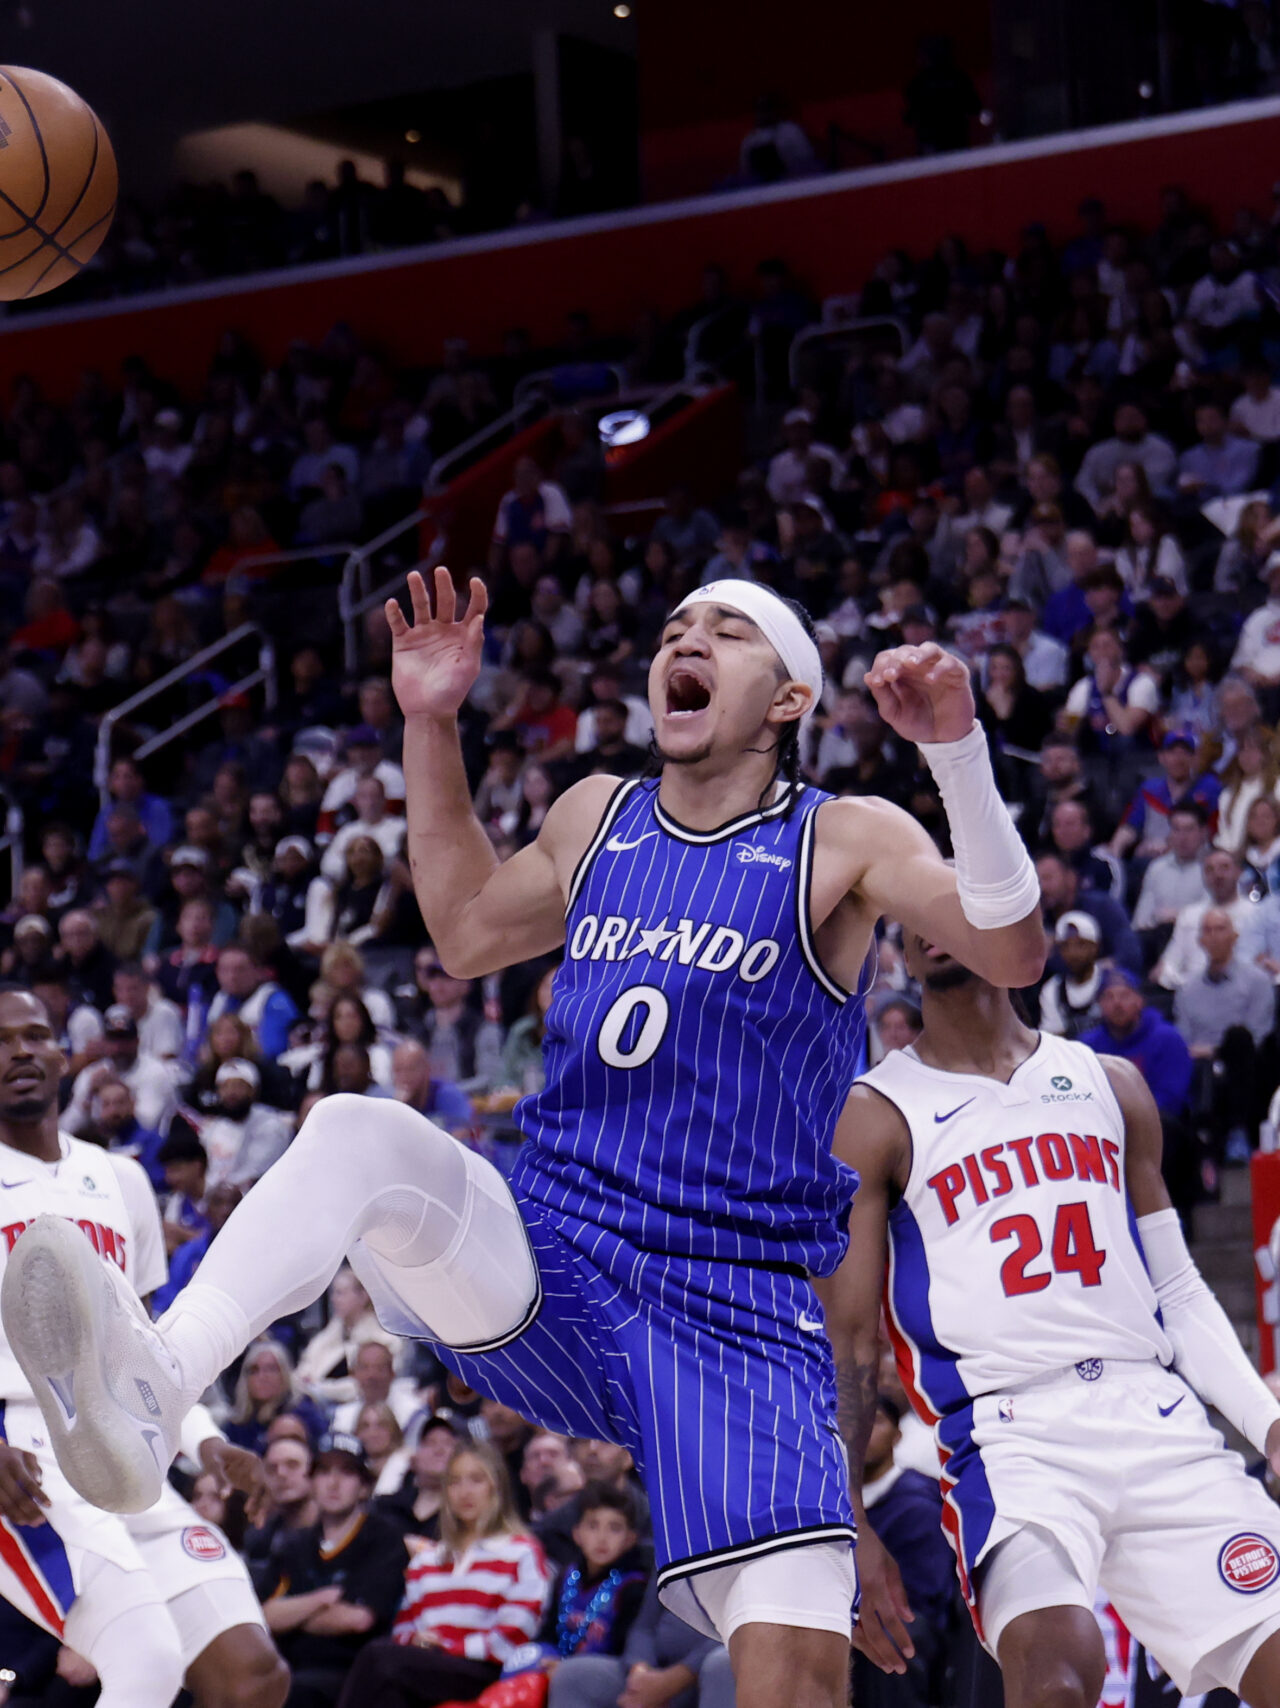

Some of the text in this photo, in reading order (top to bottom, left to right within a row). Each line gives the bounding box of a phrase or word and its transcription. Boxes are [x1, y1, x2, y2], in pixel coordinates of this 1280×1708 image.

[734, 842, 792, 872] Disney
[597, 983, 669, 1070] 0
[926, 1131, 1122, 1228] PISTONS
[989, 1200, 1107, 1298] 24
[1228, 1547, 1266, 1570] DETROIT
[1232, 1556, 1273, 1580] PISTONS
